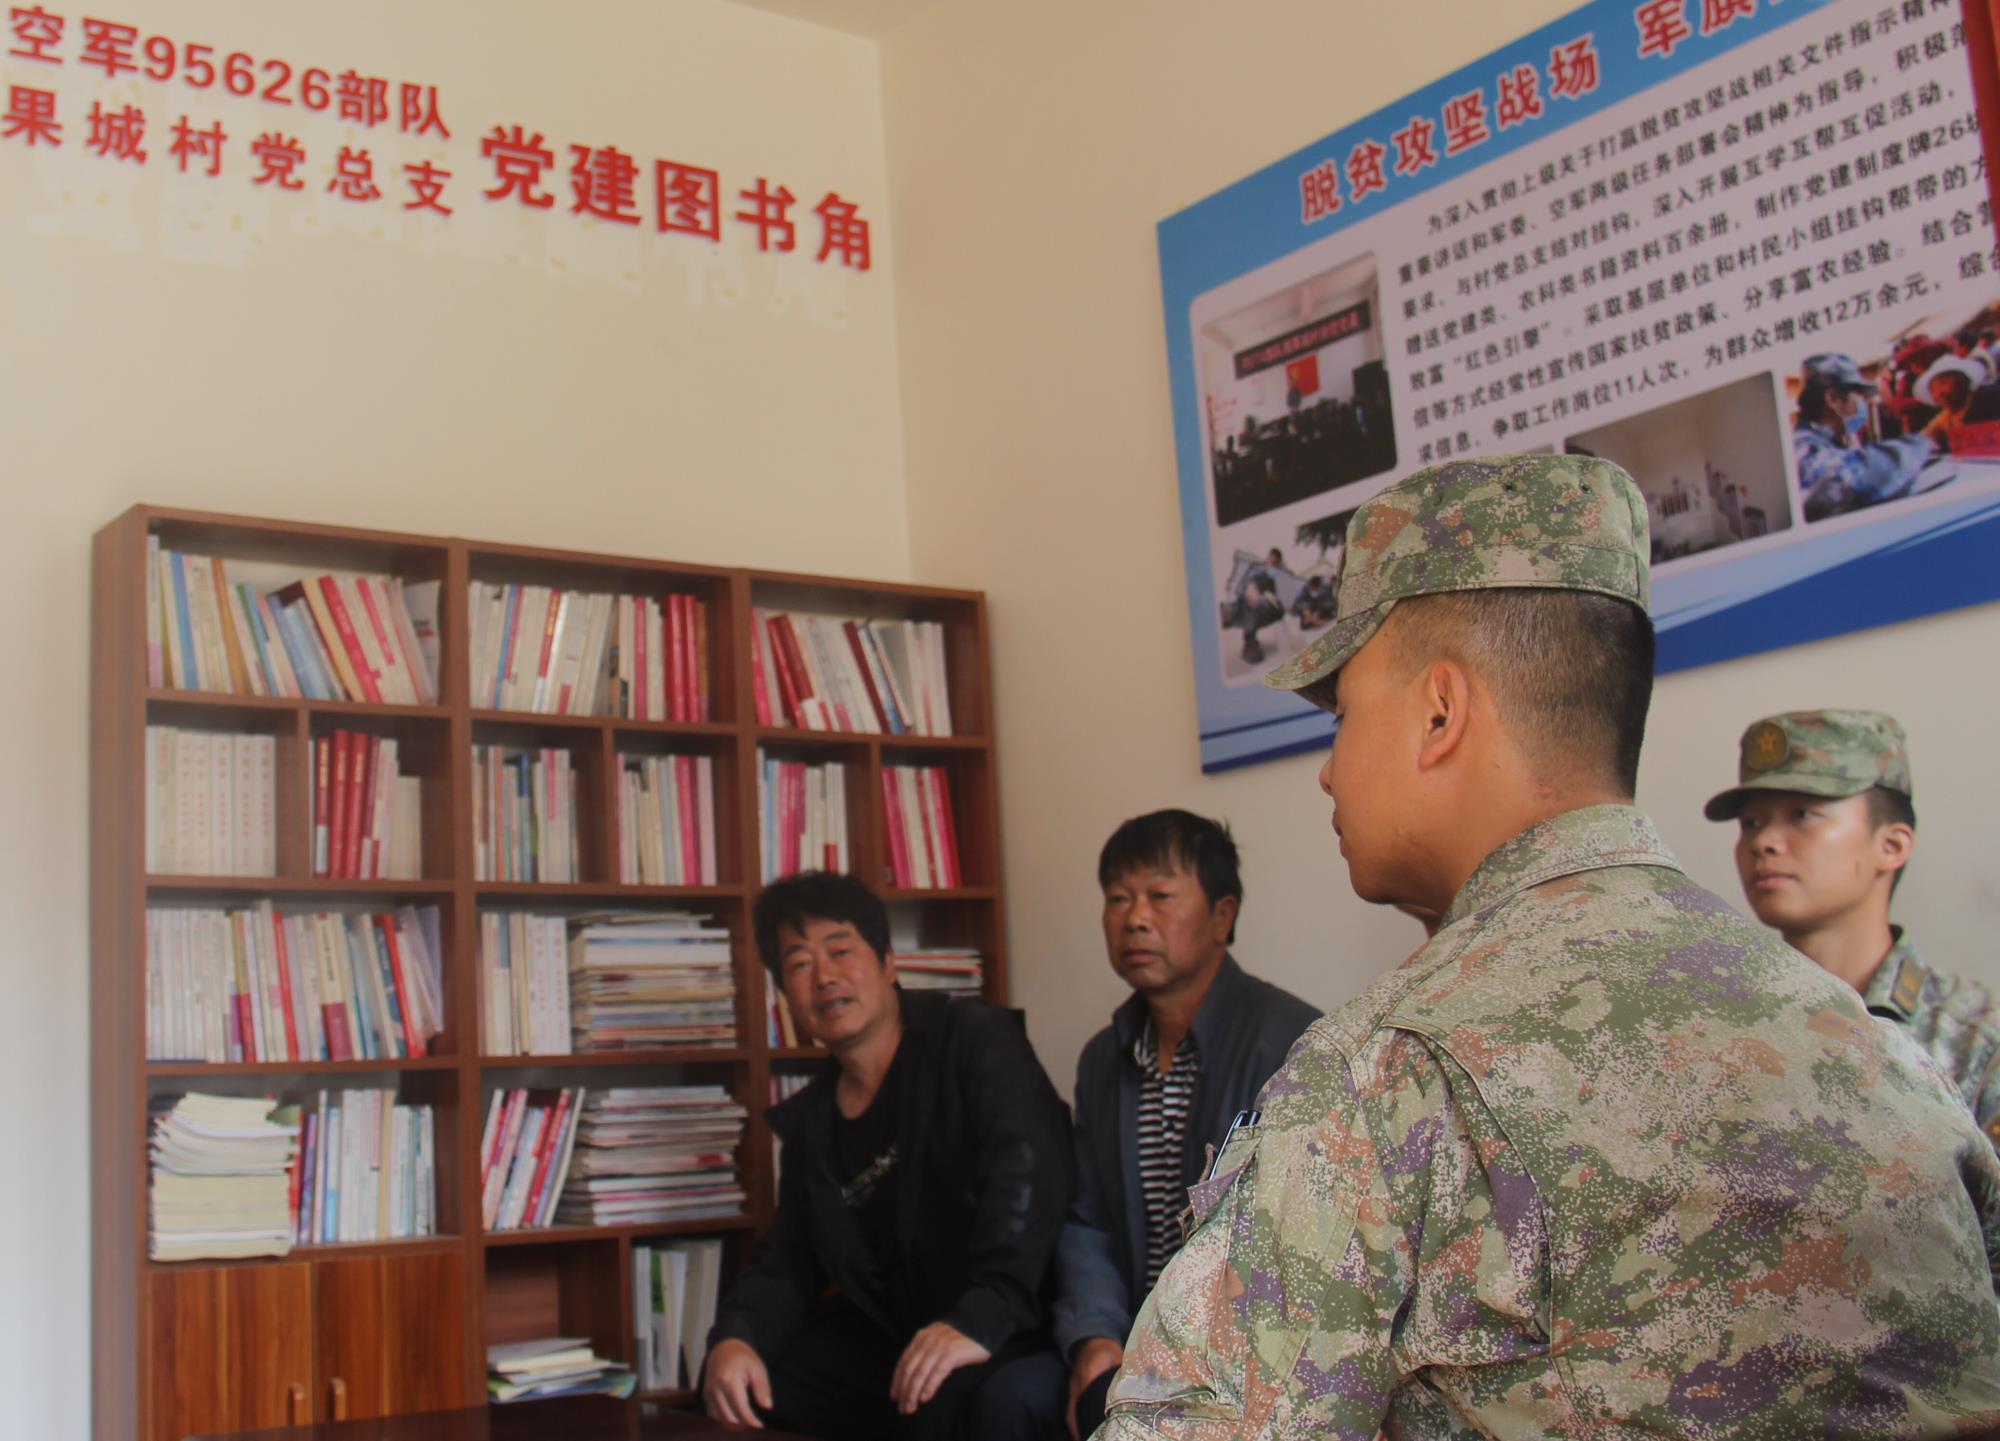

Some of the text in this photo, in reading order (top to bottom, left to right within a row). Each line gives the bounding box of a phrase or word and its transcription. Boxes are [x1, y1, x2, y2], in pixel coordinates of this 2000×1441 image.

[8, 5, 452, 140] 空军95626部队
[1299, 34, 1600, 224] 脱贫攻坚战场
[2, 84, 454, 216] 果城村党总支
[481, 124, 874, 271] 党建图书角
